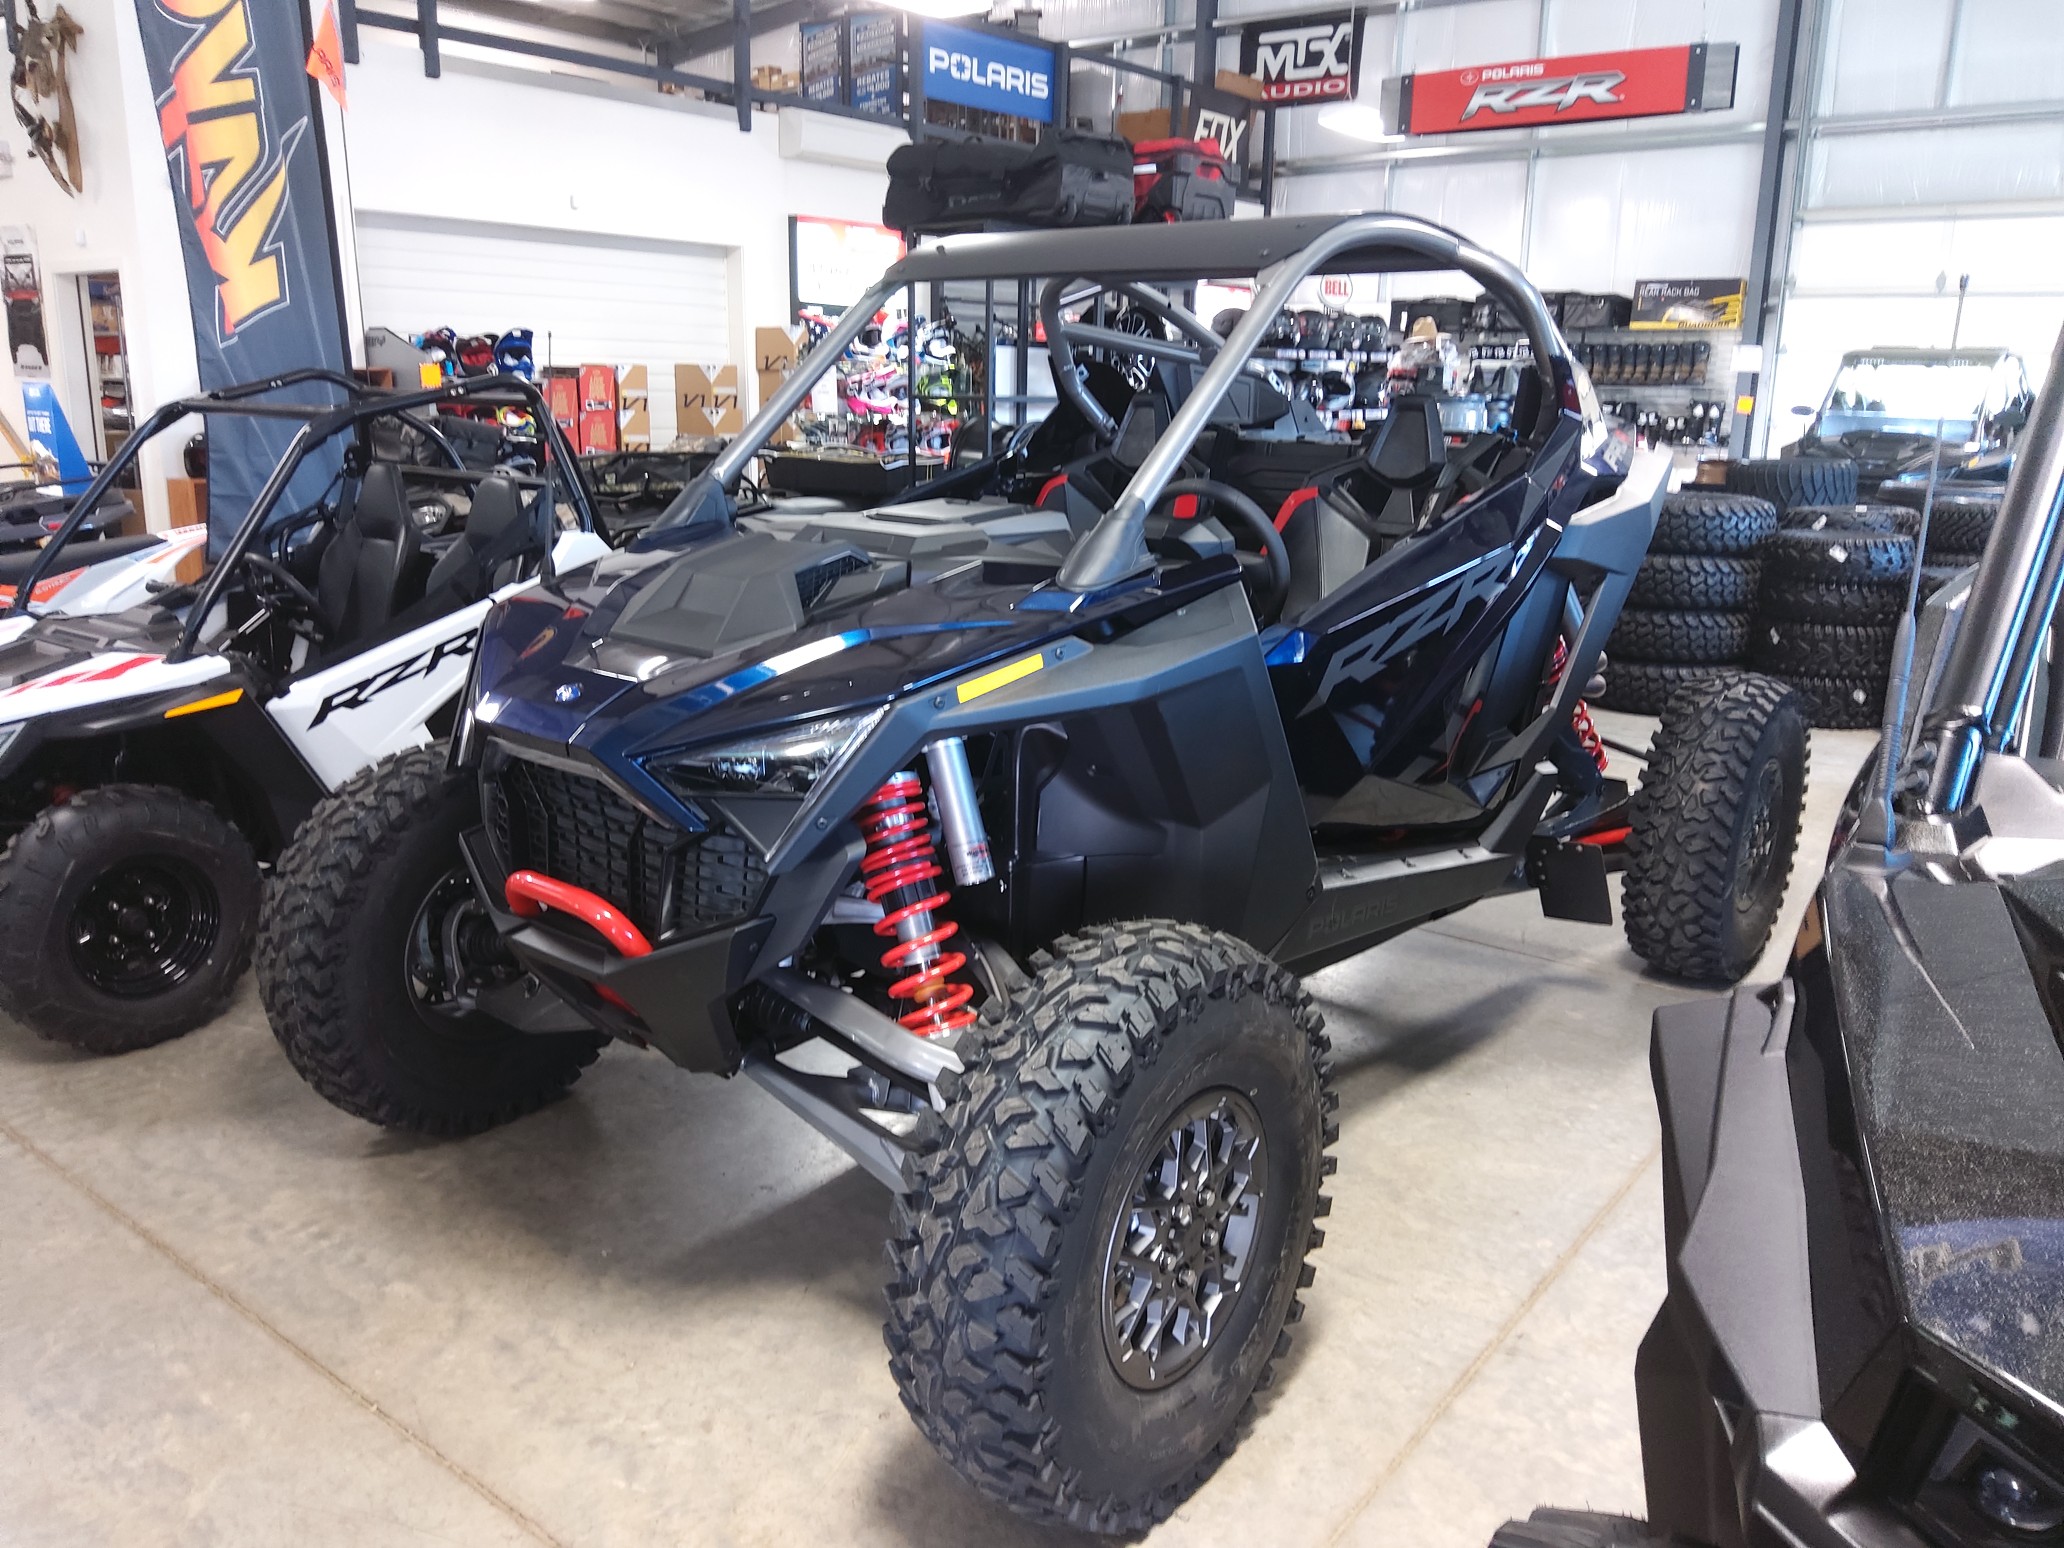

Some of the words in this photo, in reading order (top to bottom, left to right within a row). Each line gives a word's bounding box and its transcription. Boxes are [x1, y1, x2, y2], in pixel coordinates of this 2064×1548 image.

[929, 46, 1049, 100] POLARIS
[1459, 70, 1627, 123] RZR
[1482, 63, 1545, 82] POLARIS
[1194, 107, 1247, 164] FOX
[1324, 279, 1349, 298] BELL
[1295, 545, 1520, 719] RZR
[306, 626, 479, 732] RZR
